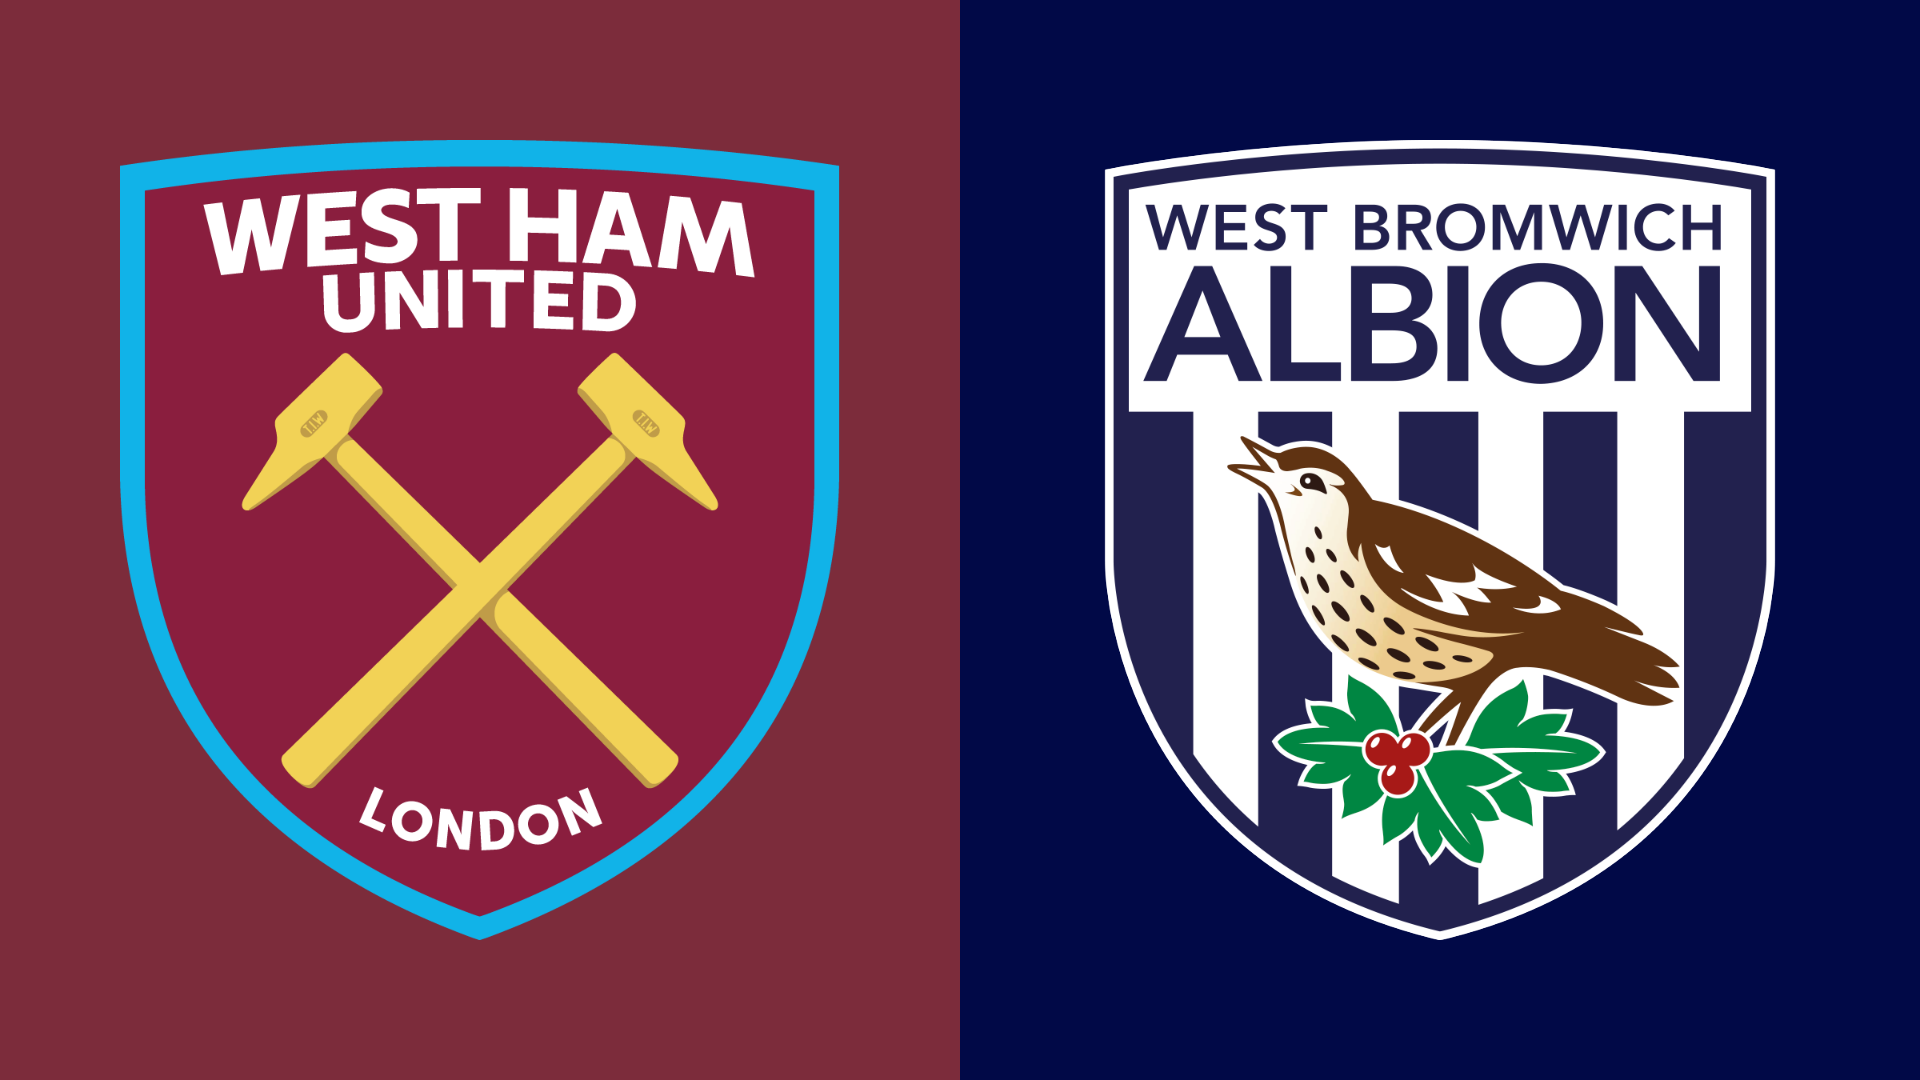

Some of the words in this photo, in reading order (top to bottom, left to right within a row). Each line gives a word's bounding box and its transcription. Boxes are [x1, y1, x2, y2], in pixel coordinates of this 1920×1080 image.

[204, 188, 481, 275] WEST
[510, 188, 754, 277] HAM
[1146, 204, 1327, 251] WEST
[1355, 204, 1721, 251] BROMWICH
[323, 270, 636, 333] UNITED
[1144, 263, 1720, 384] ALBION
[359, 787, 602, 850] LONDON
